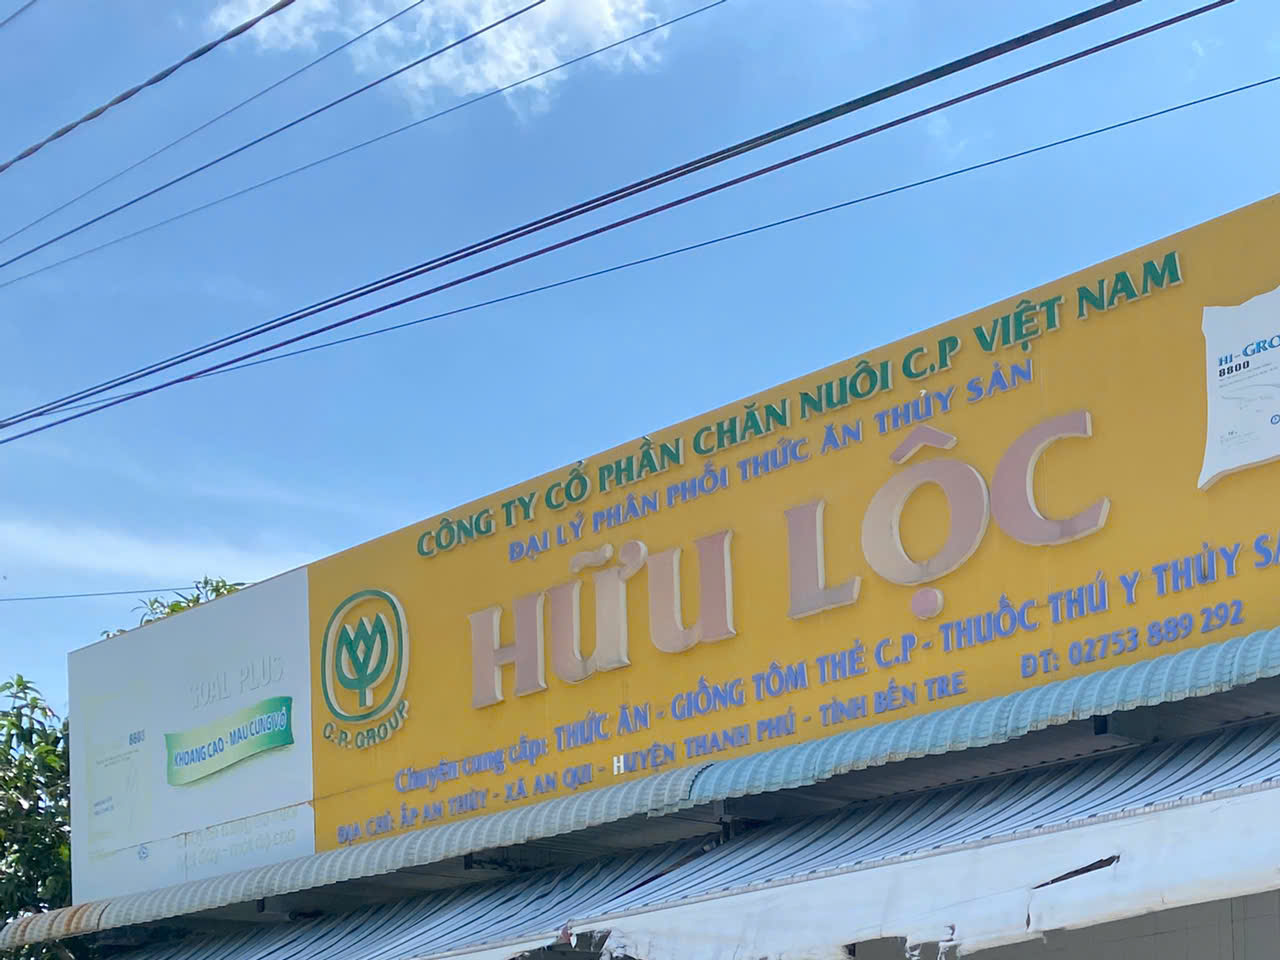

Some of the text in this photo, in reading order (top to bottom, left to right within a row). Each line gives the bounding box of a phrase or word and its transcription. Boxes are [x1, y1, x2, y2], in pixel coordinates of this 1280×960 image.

[417, 251, 1183, 558] CÔNG TY CỔ PHẦN CHĂN NUÔI C.P VIỆT NAM
[509, 530, 549, 562] ĐẠI
[592, 490, 660, 534] PHÂN
[666, 460, 729, 508] PHỐI
[737, 436, 811, 482] THỨC
[820, 420, 862, 455] ĂN
[874, 389, 957, 435] THỦY
[967, 358, 1033, 403] SẢN
[1219, 360, 1250, 378] 8800
[468, 409, 1111, 709] HỮU LỘC
[1020, 648, 1060, 680] ĐT:
[1068, 627, 1139, 667] 02753
[1146, 613, 1193, 648] 889
[1199, 599, 1245, 634] 292
[395, 759, 460, 792] Chuyên
[462, 749, 505, 775] cung
[554, 709, 612, 752] THỨC
[617, 703, 651, 736] ĂN
[752, 661, 809, 701] TÔM
[939, 592, 1040, 653] THUỐC
[1047, 571, 1109, 625] THÚ
[1119, 571, 1144, 607] Y
[1152, 541, 1242, 600] THỦY
[533, 772, 557, 795] AN
[613, 741, 676, 776] HUYỆN
[924, 670, 968, 701] TRE
